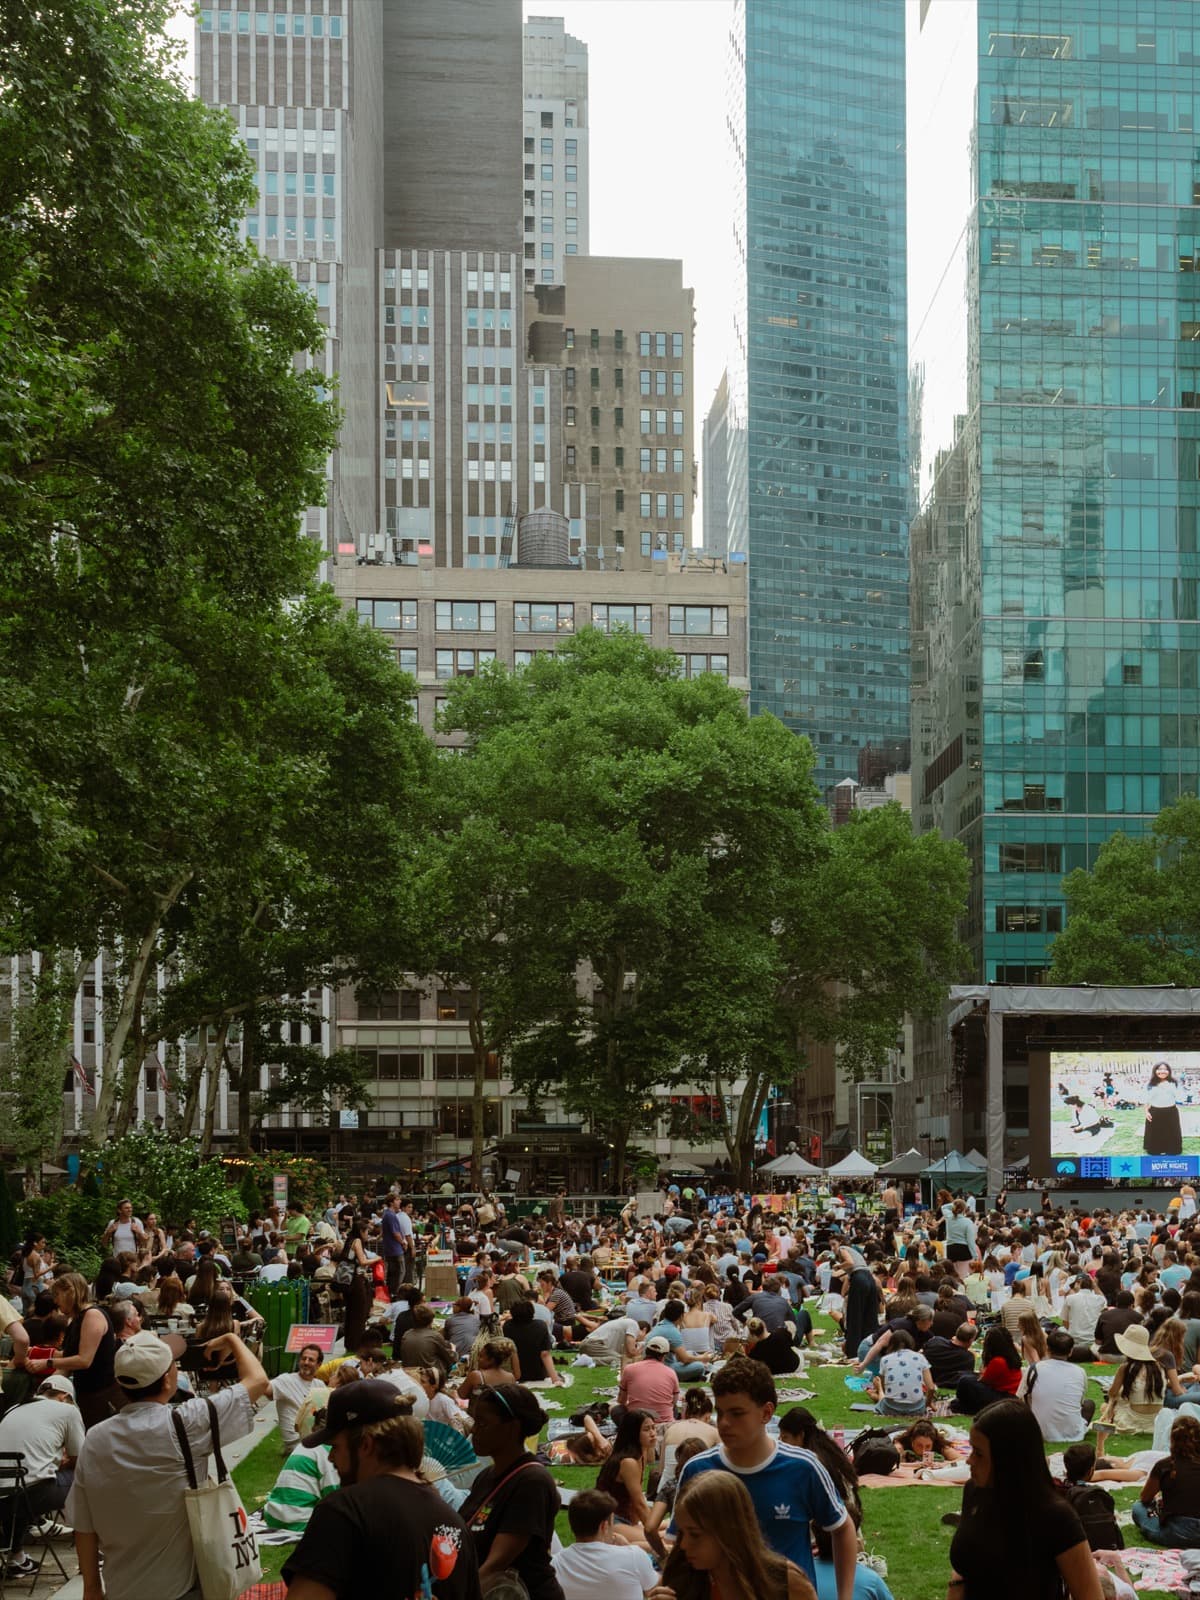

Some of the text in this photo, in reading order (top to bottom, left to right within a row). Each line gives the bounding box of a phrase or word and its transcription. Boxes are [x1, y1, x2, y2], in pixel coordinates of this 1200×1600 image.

[1151, 1162, 1169, 1171] MOVIE
[1169, 1162, 1189, 1172] NIGHTS
[228, 1511, 245, 1539] I
[231, 1532, 259, 1570] NY
